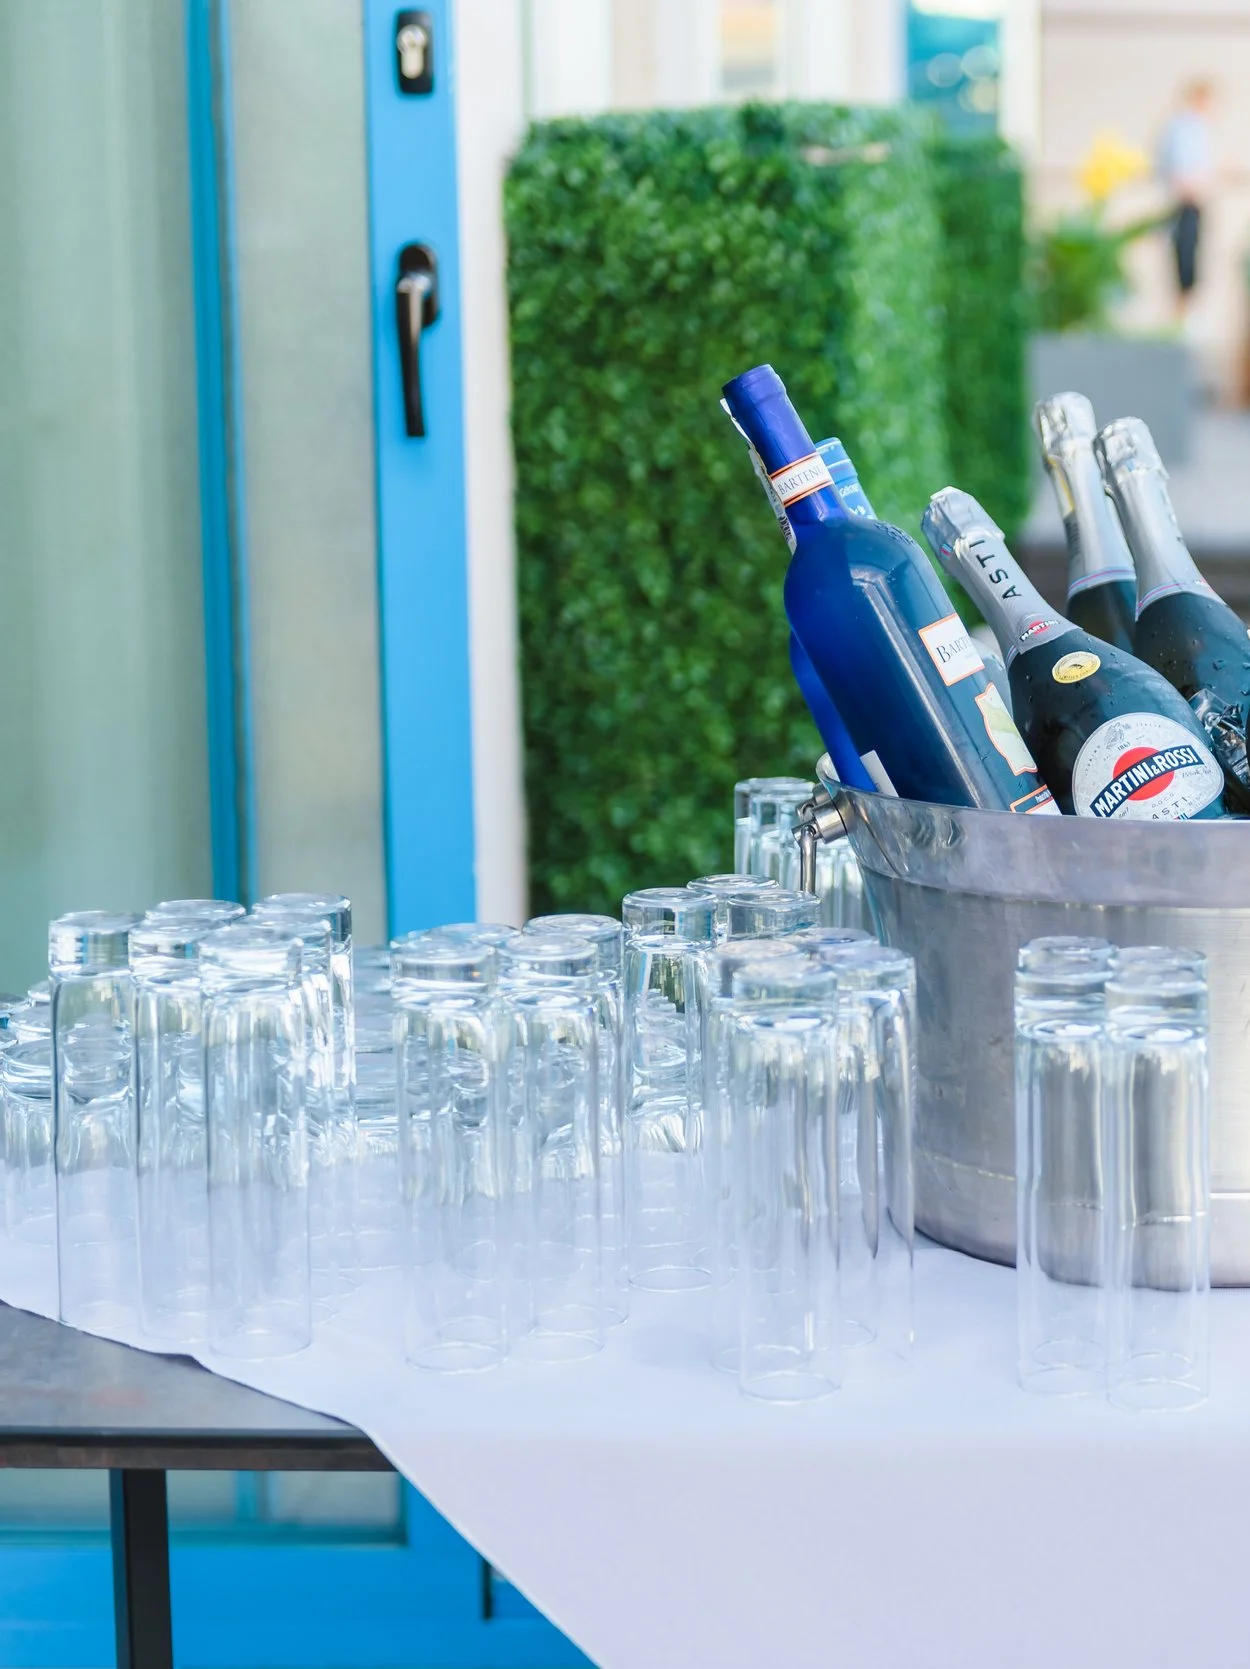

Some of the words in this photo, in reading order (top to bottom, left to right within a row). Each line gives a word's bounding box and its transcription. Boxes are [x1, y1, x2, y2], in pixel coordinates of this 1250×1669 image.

[969, 539, 1023, 600] ASTI
[1021, 620, 1060, 641] MARTINI
[1152, 797, 1188, 820] ASTI
